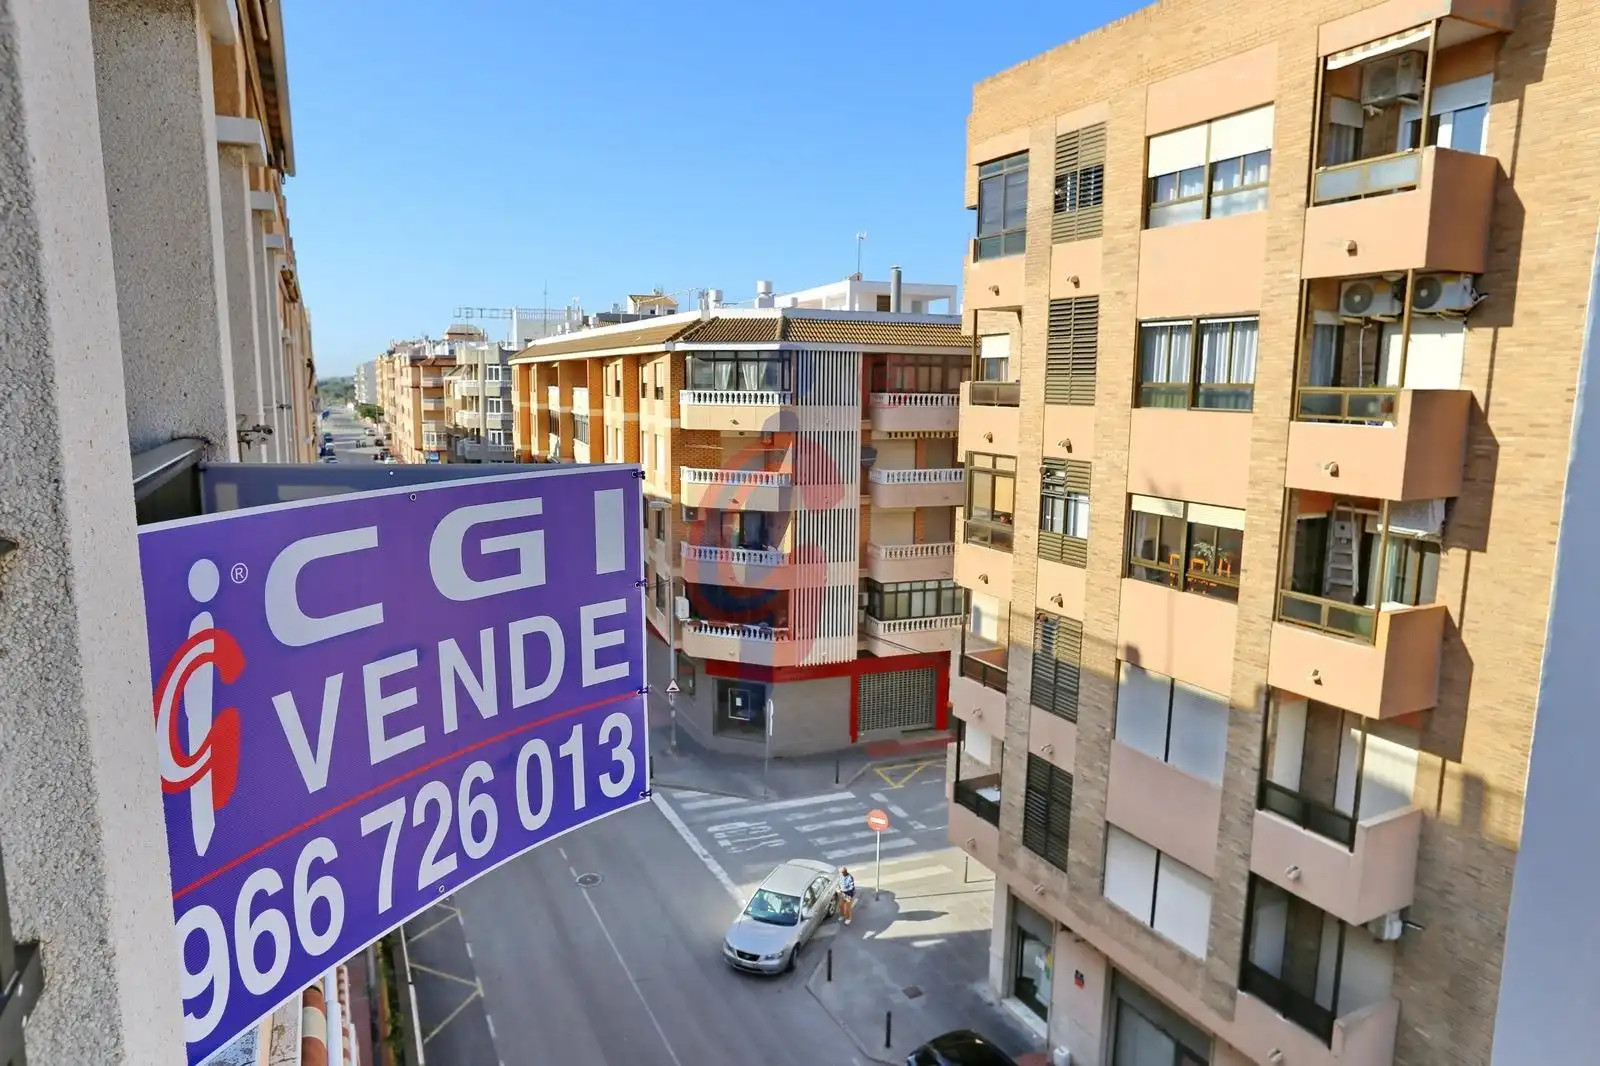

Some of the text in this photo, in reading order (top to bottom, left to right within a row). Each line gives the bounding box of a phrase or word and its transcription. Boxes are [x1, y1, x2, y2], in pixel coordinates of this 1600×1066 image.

[264, 488, 626, 647] CGI
[271, 598, 631, 795] VENDE
[175, 712, 637, 1043] 966 726 013
